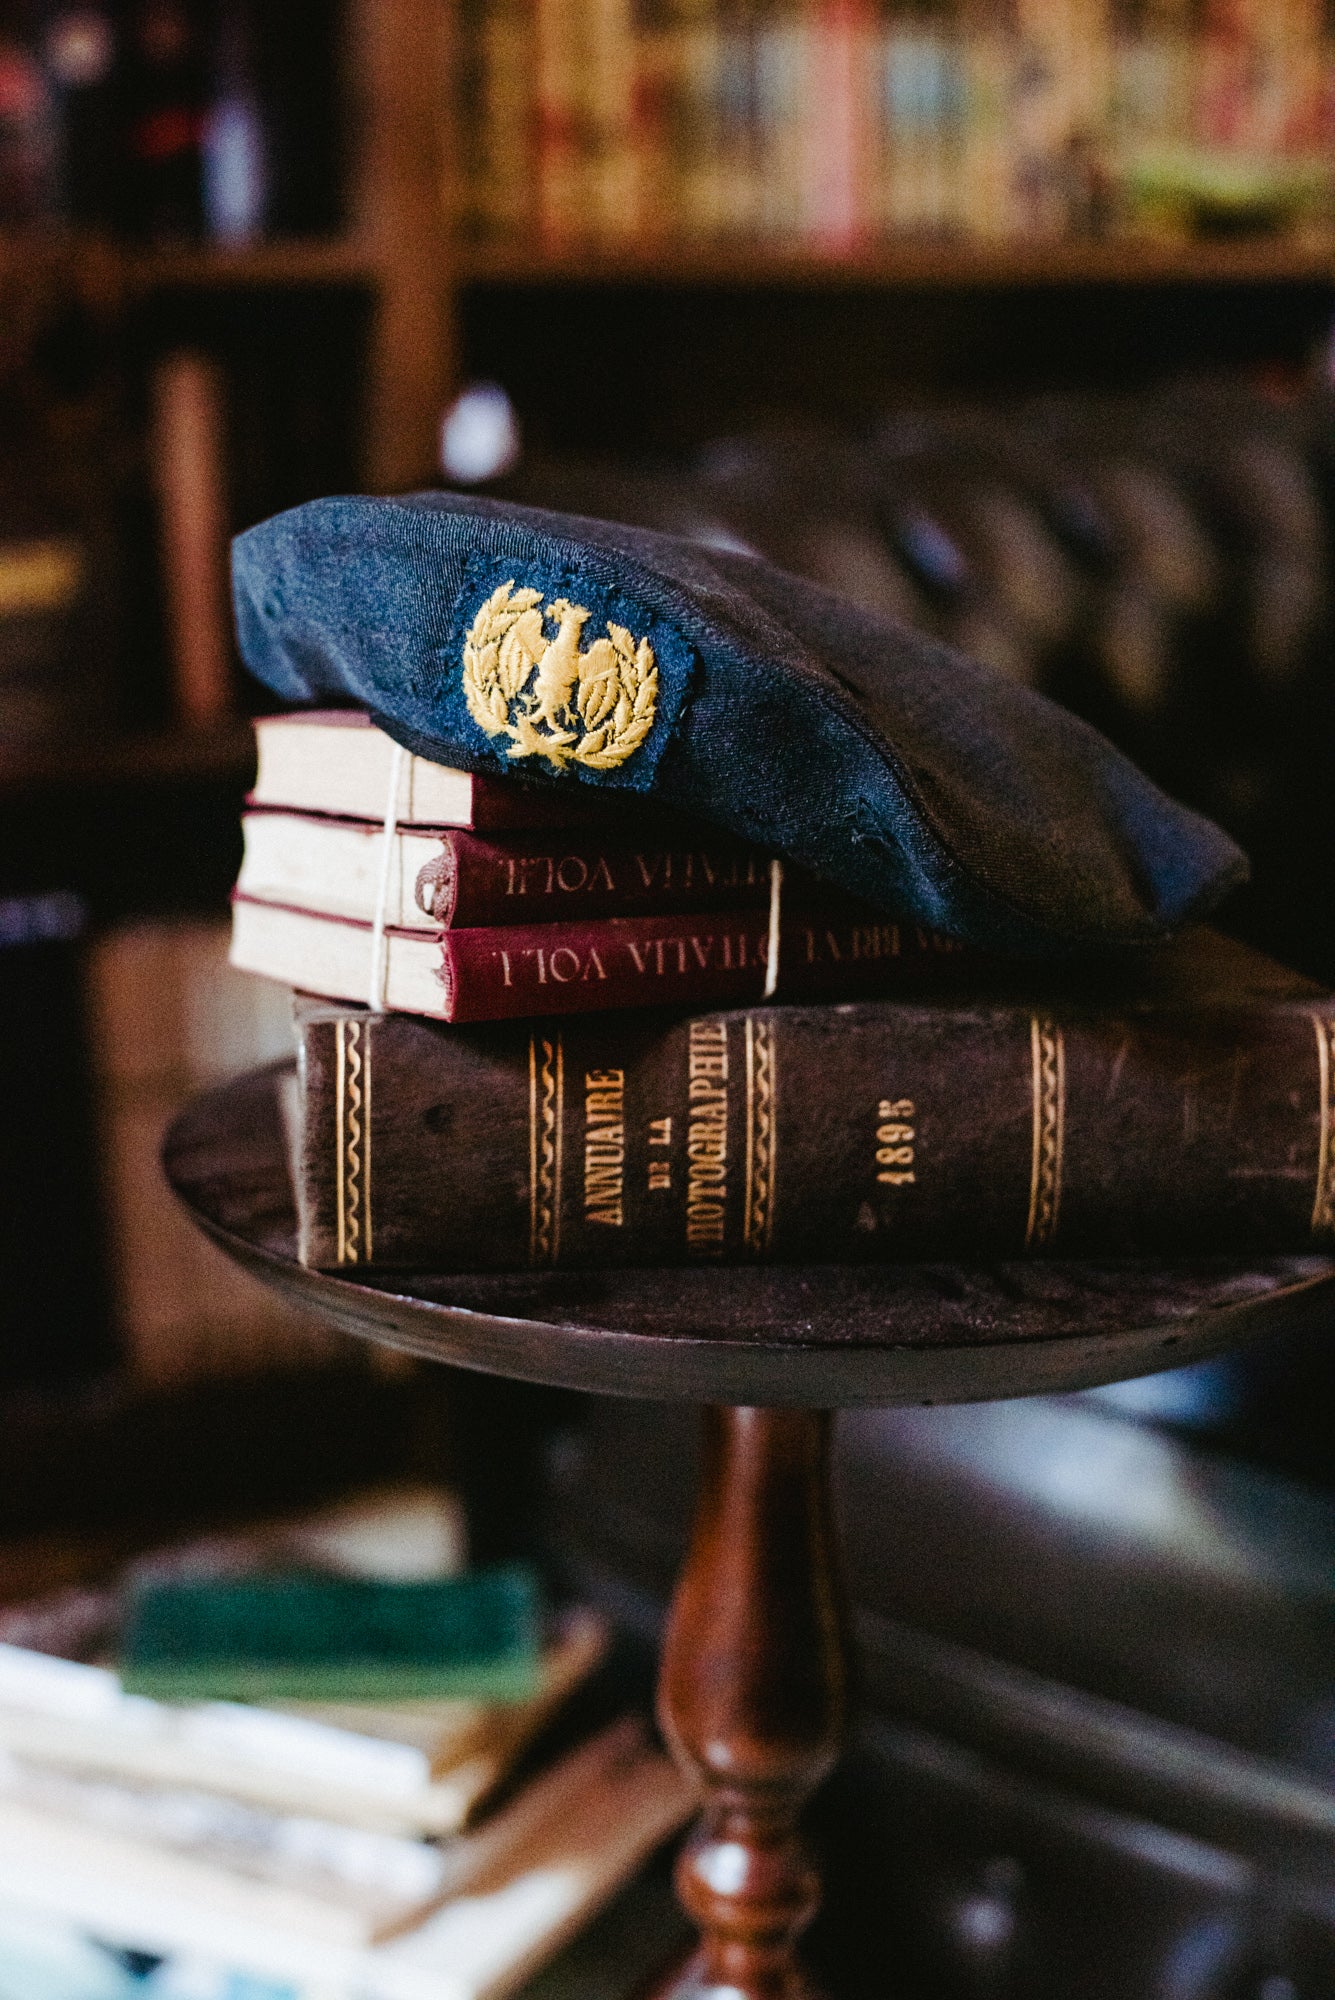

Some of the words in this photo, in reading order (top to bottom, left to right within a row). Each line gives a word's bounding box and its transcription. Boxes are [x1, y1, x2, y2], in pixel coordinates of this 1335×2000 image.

[491, 950, 513, 986] I.
[522, 947, 607, 985] VOL.
[584, 1069, 624, 1227] ANNUAIRE
[649, 1117, 672, 1145] LA
[876, 1099, 915, 1185] 1895
